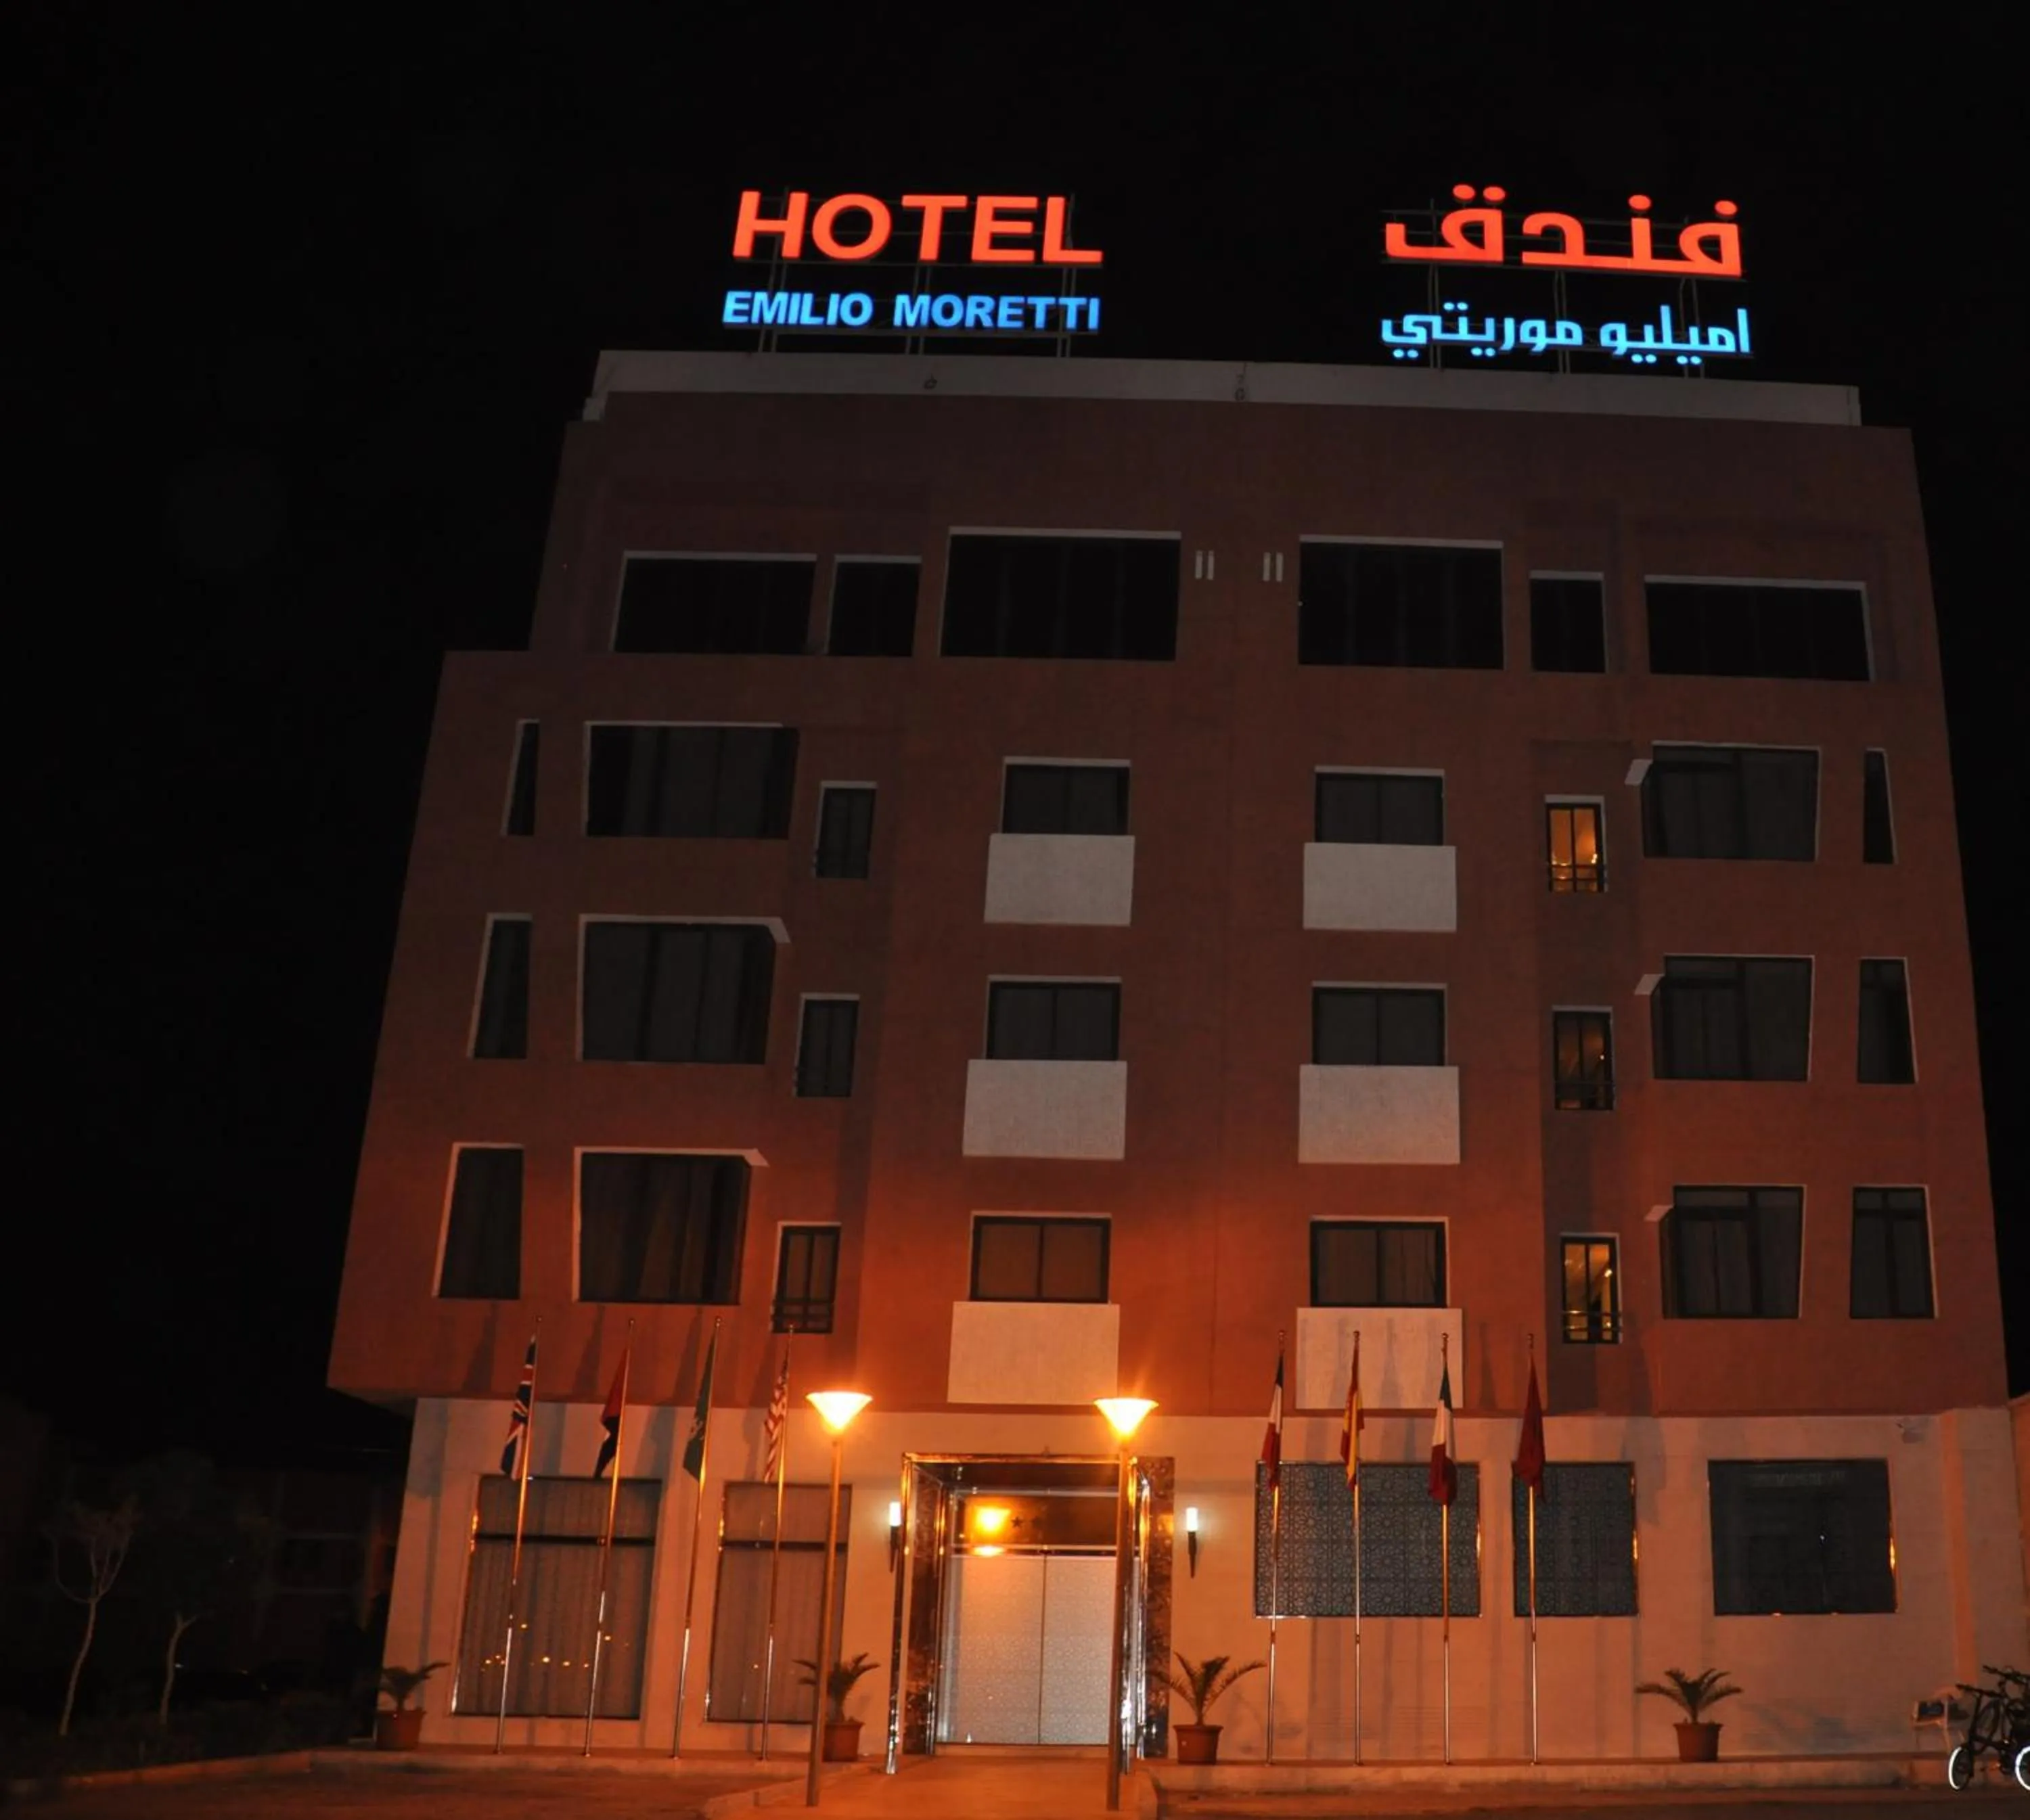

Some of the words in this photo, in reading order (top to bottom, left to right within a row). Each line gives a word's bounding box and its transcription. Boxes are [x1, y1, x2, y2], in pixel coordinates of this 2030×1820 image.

[732, 190, 1103, 263] HOTEL
[1385, 184, 1742, 277] فندق
[723, 291, 874, 326] EMILIO
[893, 294, 1100, 329] MORETTI
[1381, 302, 1583, 359] موريتي
[1599, 304, 1751, 365] اميليو
